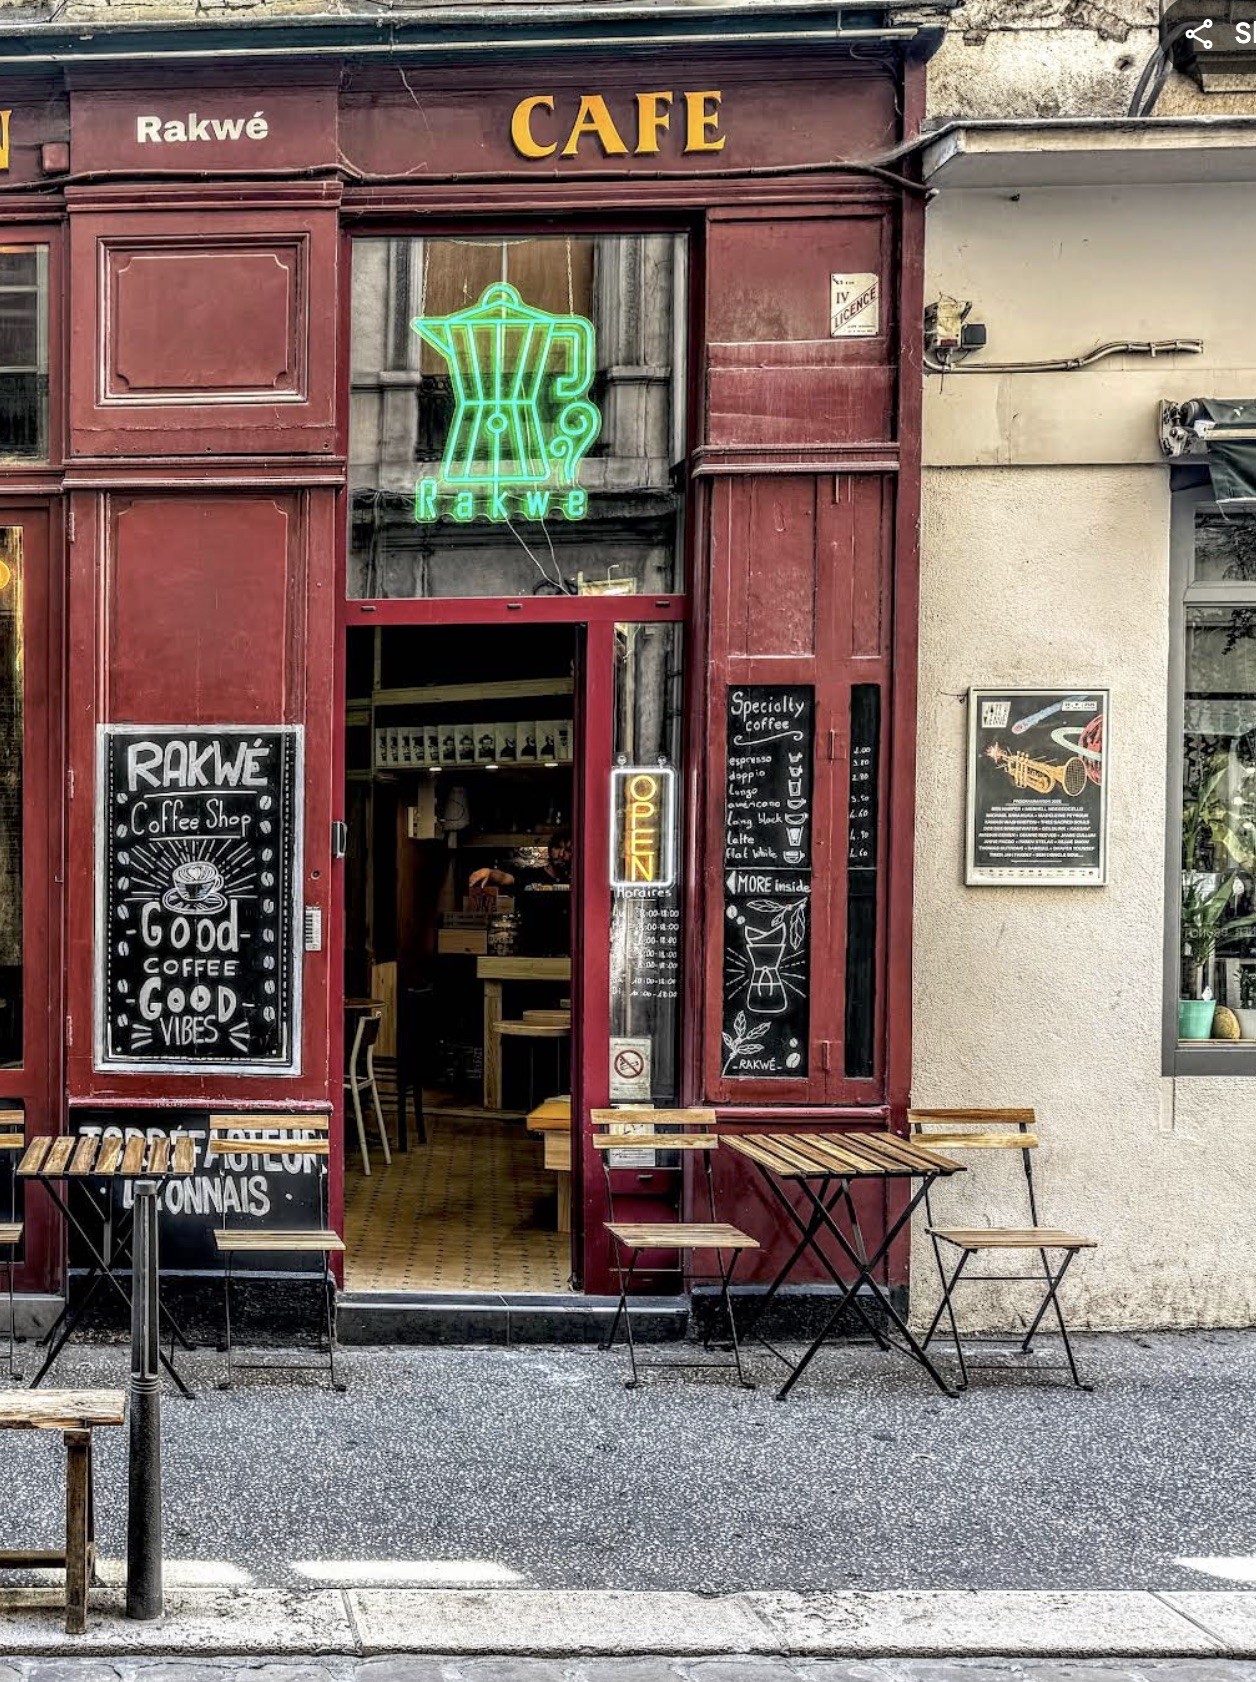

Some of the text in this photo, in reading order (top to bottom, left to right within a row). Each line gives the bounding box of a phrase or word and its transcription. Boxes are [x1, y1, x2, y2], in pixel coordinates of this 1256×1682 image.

[136, 111, 268, 143] Rakwé
[511, 91, 726, 157] CAFE
[834, 286, 876, 328] LICENCE
[836, 291, 849, 304] IV
[417, 478, 586, 519] Rakwe
[731, 691, 804, 722] Specialty
[745, 717, 789, 731] coffee
[128, 737, 270, 791] RAKWÉ
[729, 756, 772, 769] espresso
[729, 771, 766, 784] doppio
[131, 798, 252, 837] Coffee Shop
[630, 775, 657, 882] OPEN
[758, 812, 783, 825] black
[737, 875, 812, 893] MORE inside
[143, 957, 240, 977] COFFEE
[139, 976, 237, 1023] GOOD
[159, 1014, 218, 1046] VIBES
